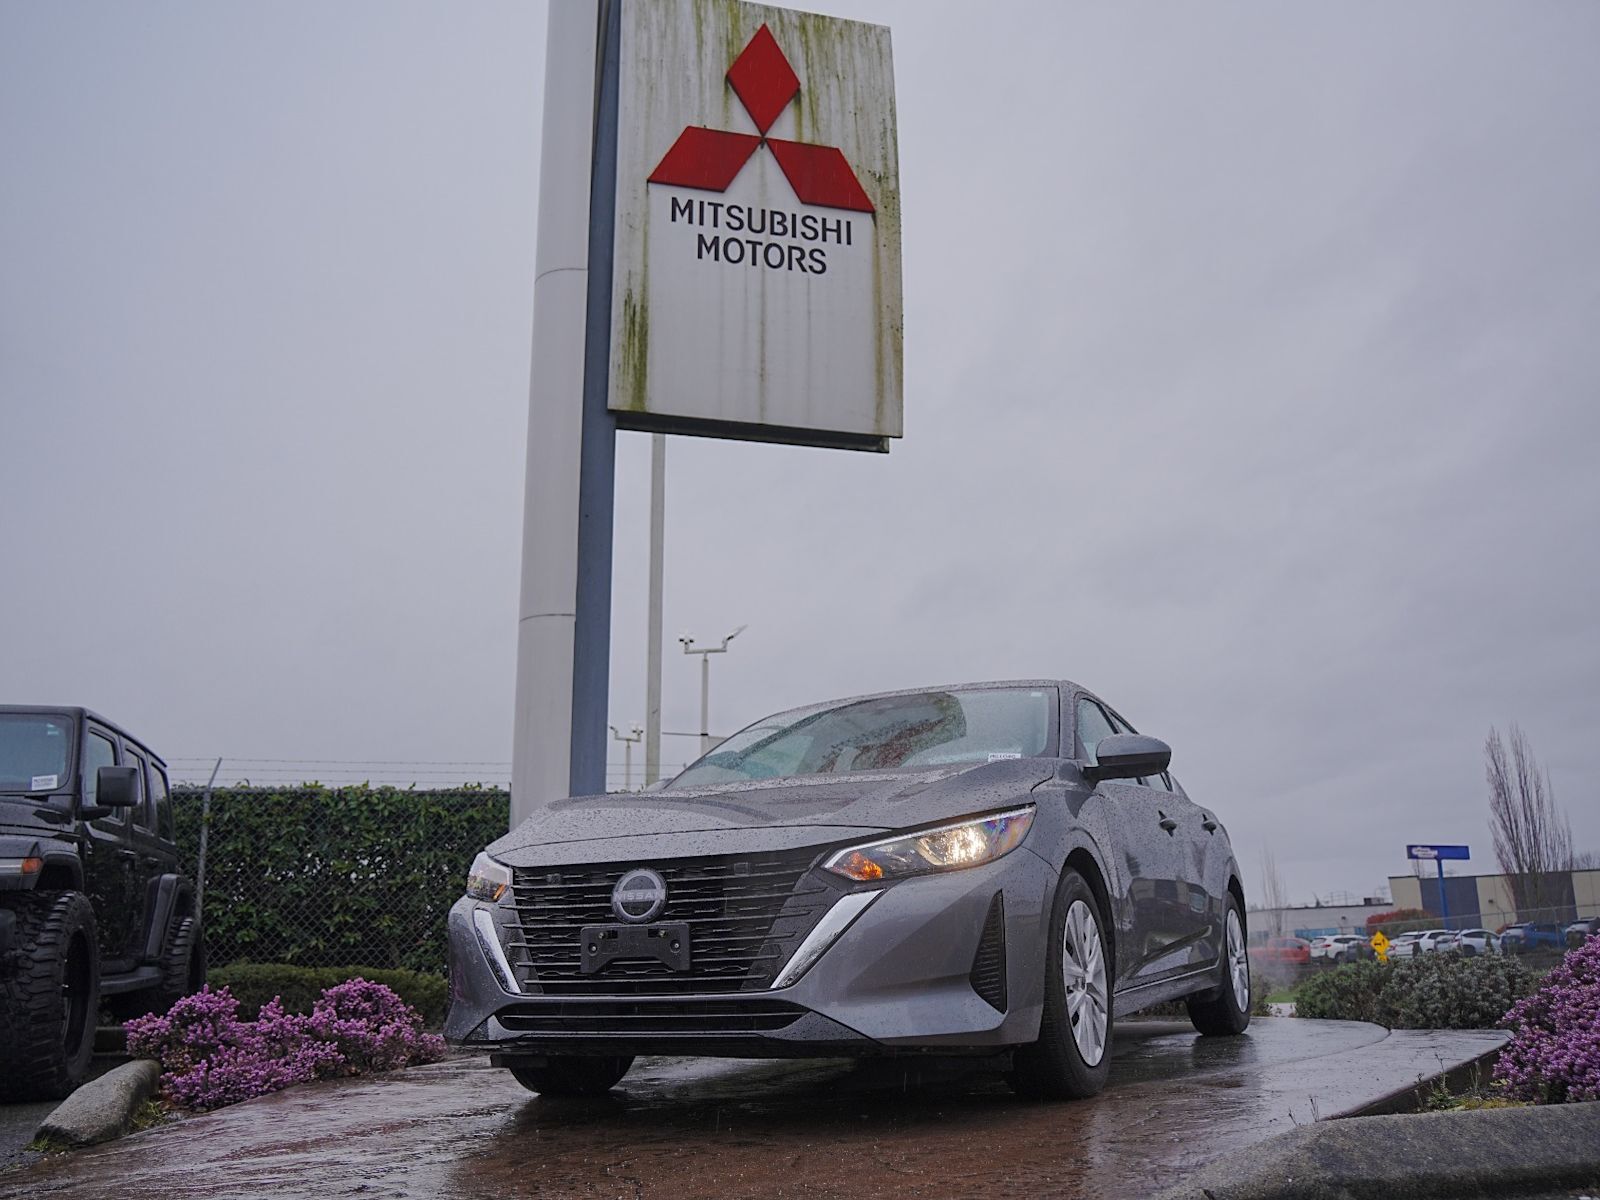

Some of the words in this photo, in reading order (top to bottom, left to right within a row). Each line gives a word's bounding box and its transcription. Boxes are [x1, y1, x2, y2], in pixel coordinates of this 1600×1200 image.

[671, 197, 852, 245] MITSUBISHI
[697, 234, 827, 275] MOTORS
[613, 890, 665, 902] NISSAN
